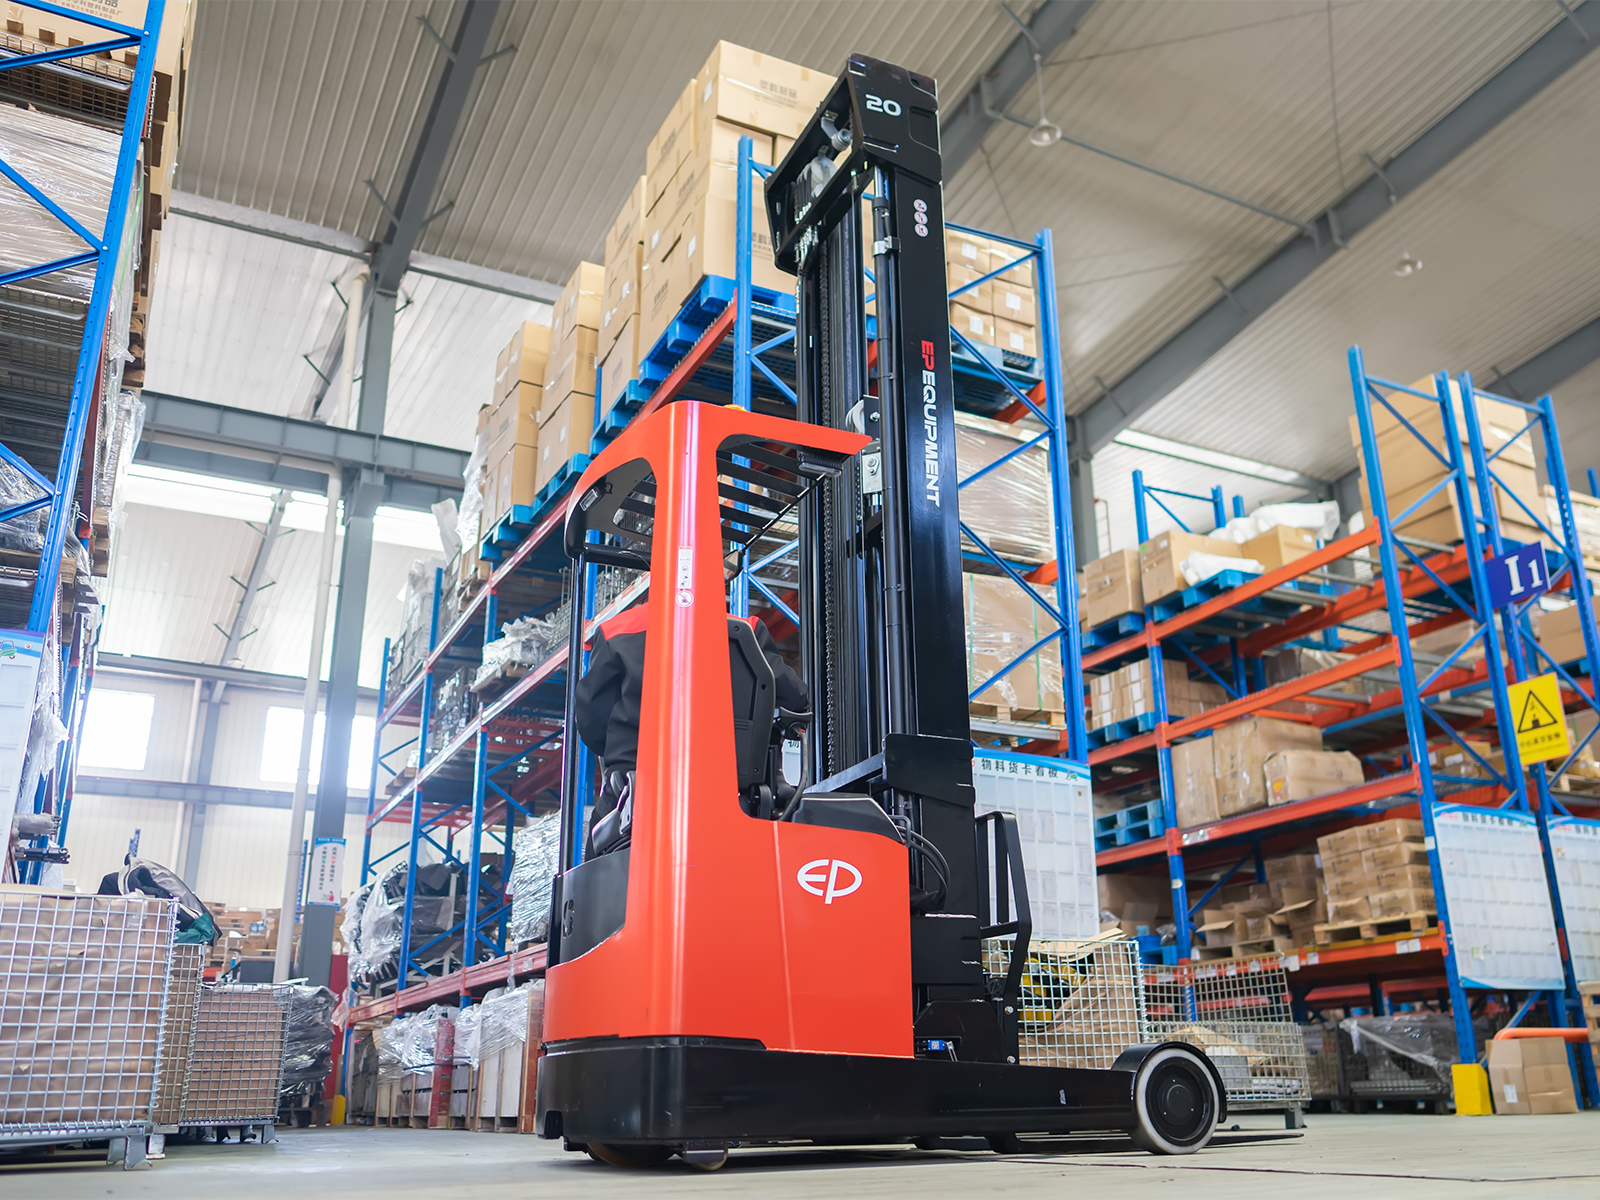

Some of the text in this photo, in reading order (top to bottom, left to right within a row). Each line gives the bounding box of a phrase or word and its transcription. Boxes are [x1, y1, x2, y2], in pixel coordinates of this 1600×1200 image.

[865, 93, 902, 117] 20
[981, 758, 1059, 779] 物料货卡看板
[797, 859, 863, 905] EP
